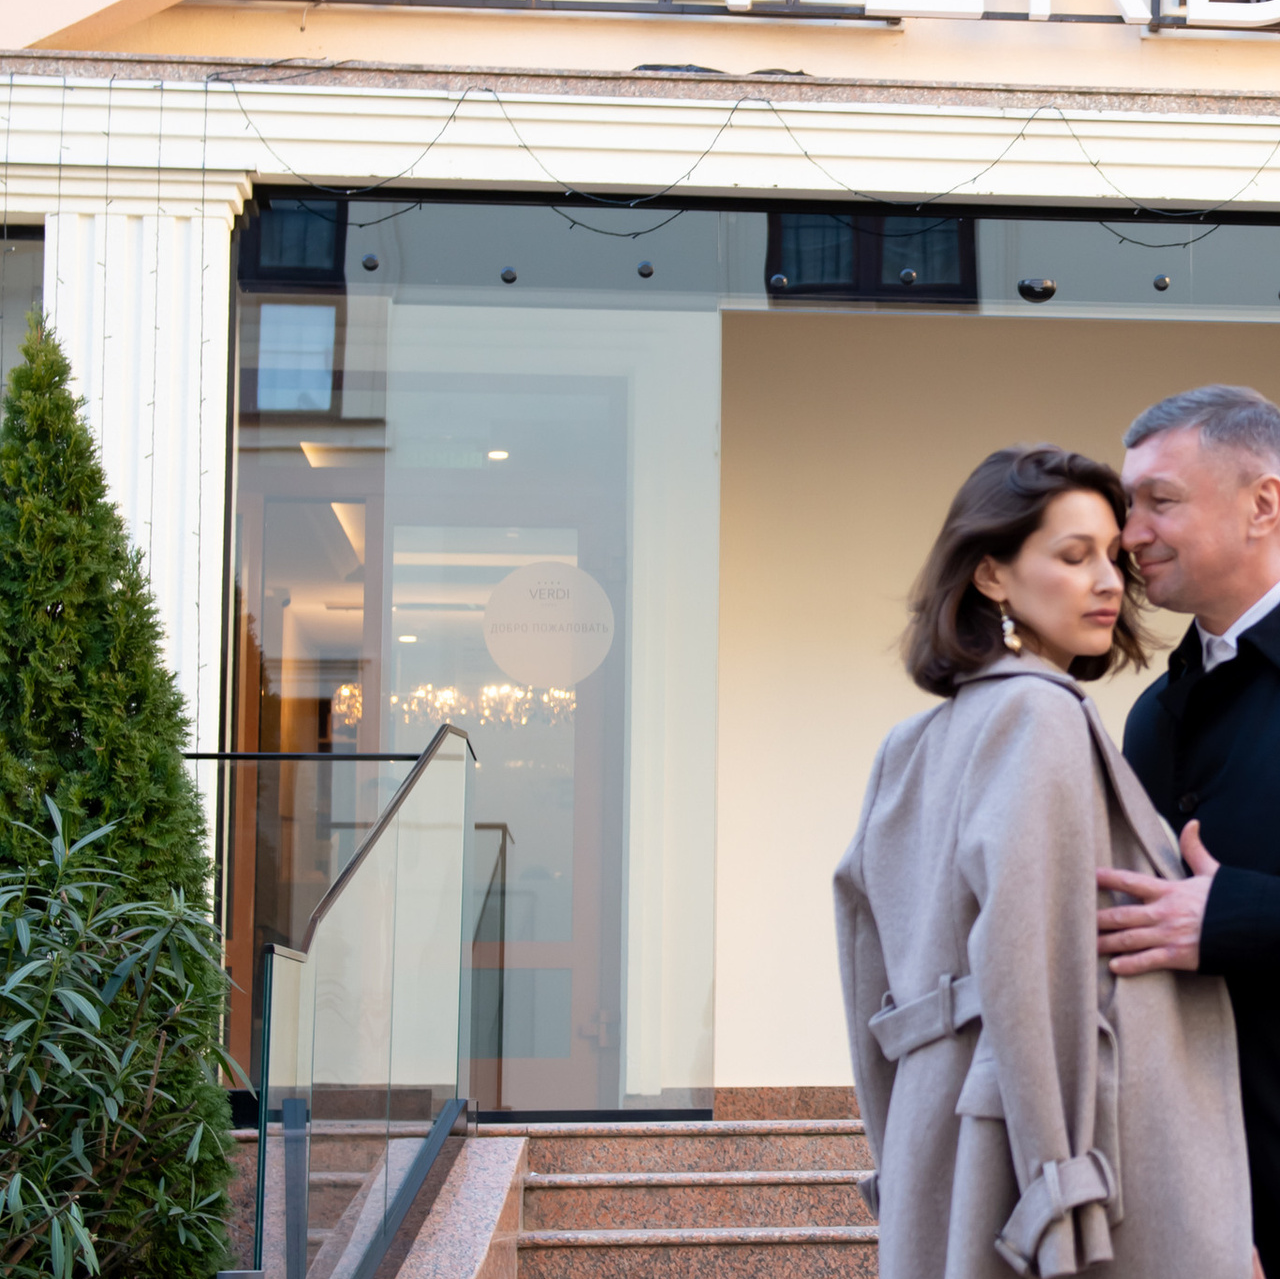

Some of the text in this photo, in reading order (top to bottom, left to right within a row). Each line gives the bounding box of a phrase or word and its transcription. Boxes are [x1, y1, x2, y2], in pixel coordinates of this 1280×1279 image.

[529, 588, 570, 600] VERDI
[490, 623, 609, 634] ДОБРО ПОЖАЛОВАТЬ
